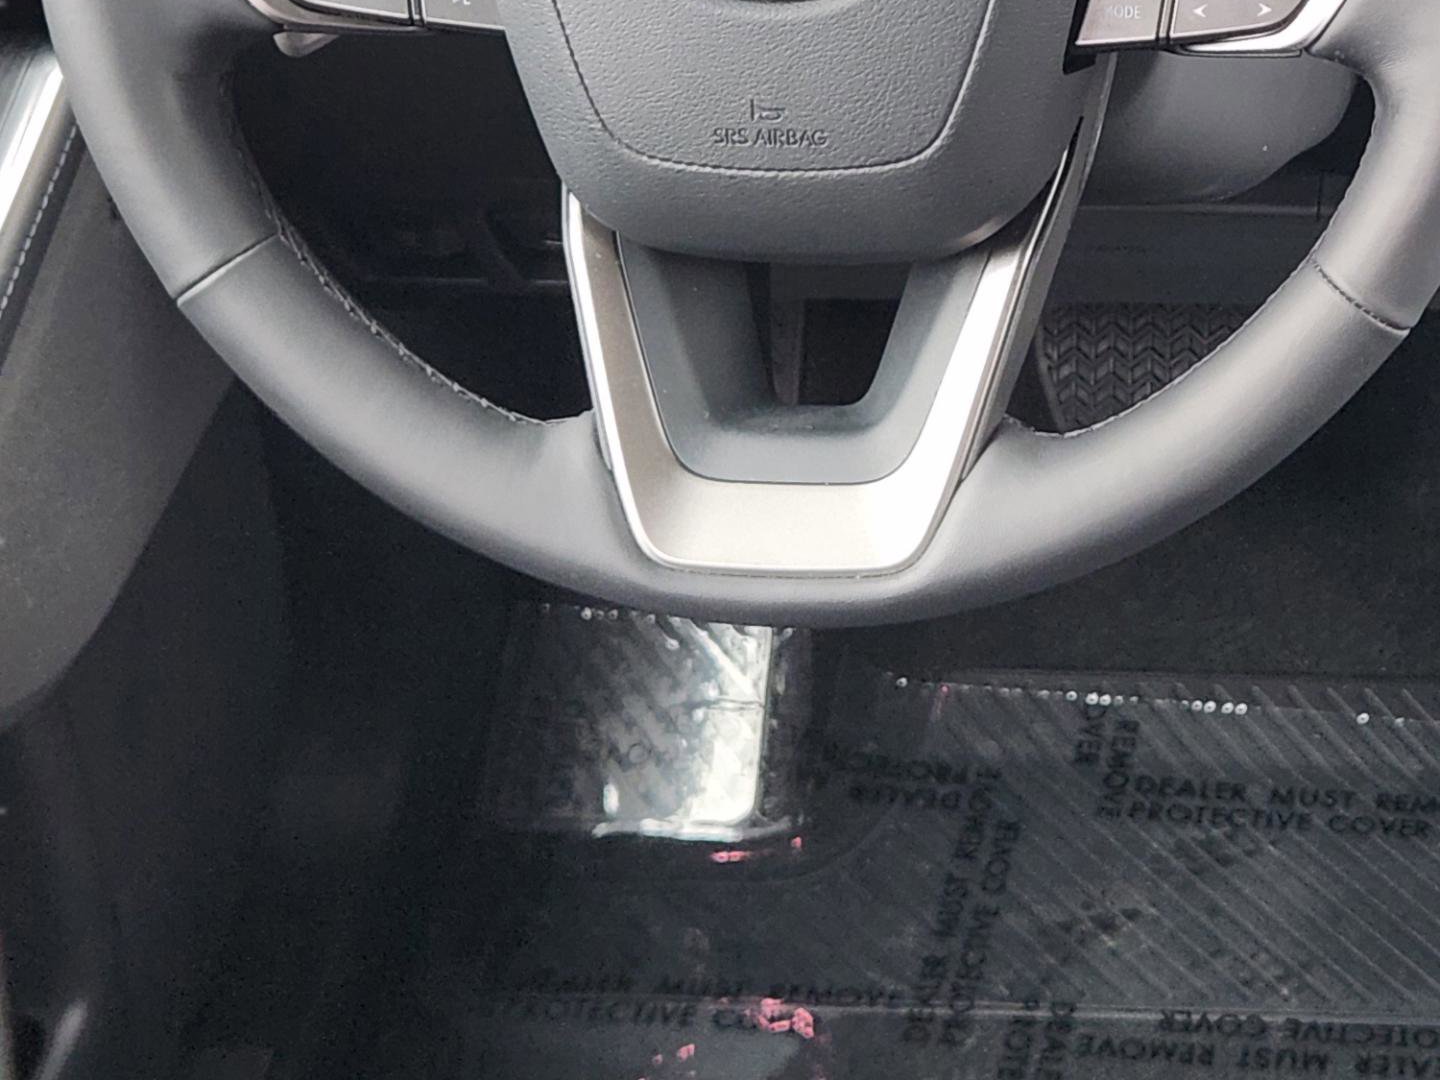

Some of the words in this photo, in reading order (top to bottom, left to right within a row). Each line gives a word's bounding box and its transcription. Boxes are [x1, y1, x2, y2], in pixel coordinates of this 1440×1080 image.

[713, 127, 749, 145] SRS
[753, 127, 828, 146] AIRBAG
[1134, 773, 1247, 801] DEALER
[1270, 787, 1355, 812] MUST
[1131, 799, 1312, 831] PROTECTIVE
[1329, 814, 1433, 840] COVER
[1074, 1034, 1214, 1066] REMOVE
[1235, 1048, 1328, 1077] MUST
